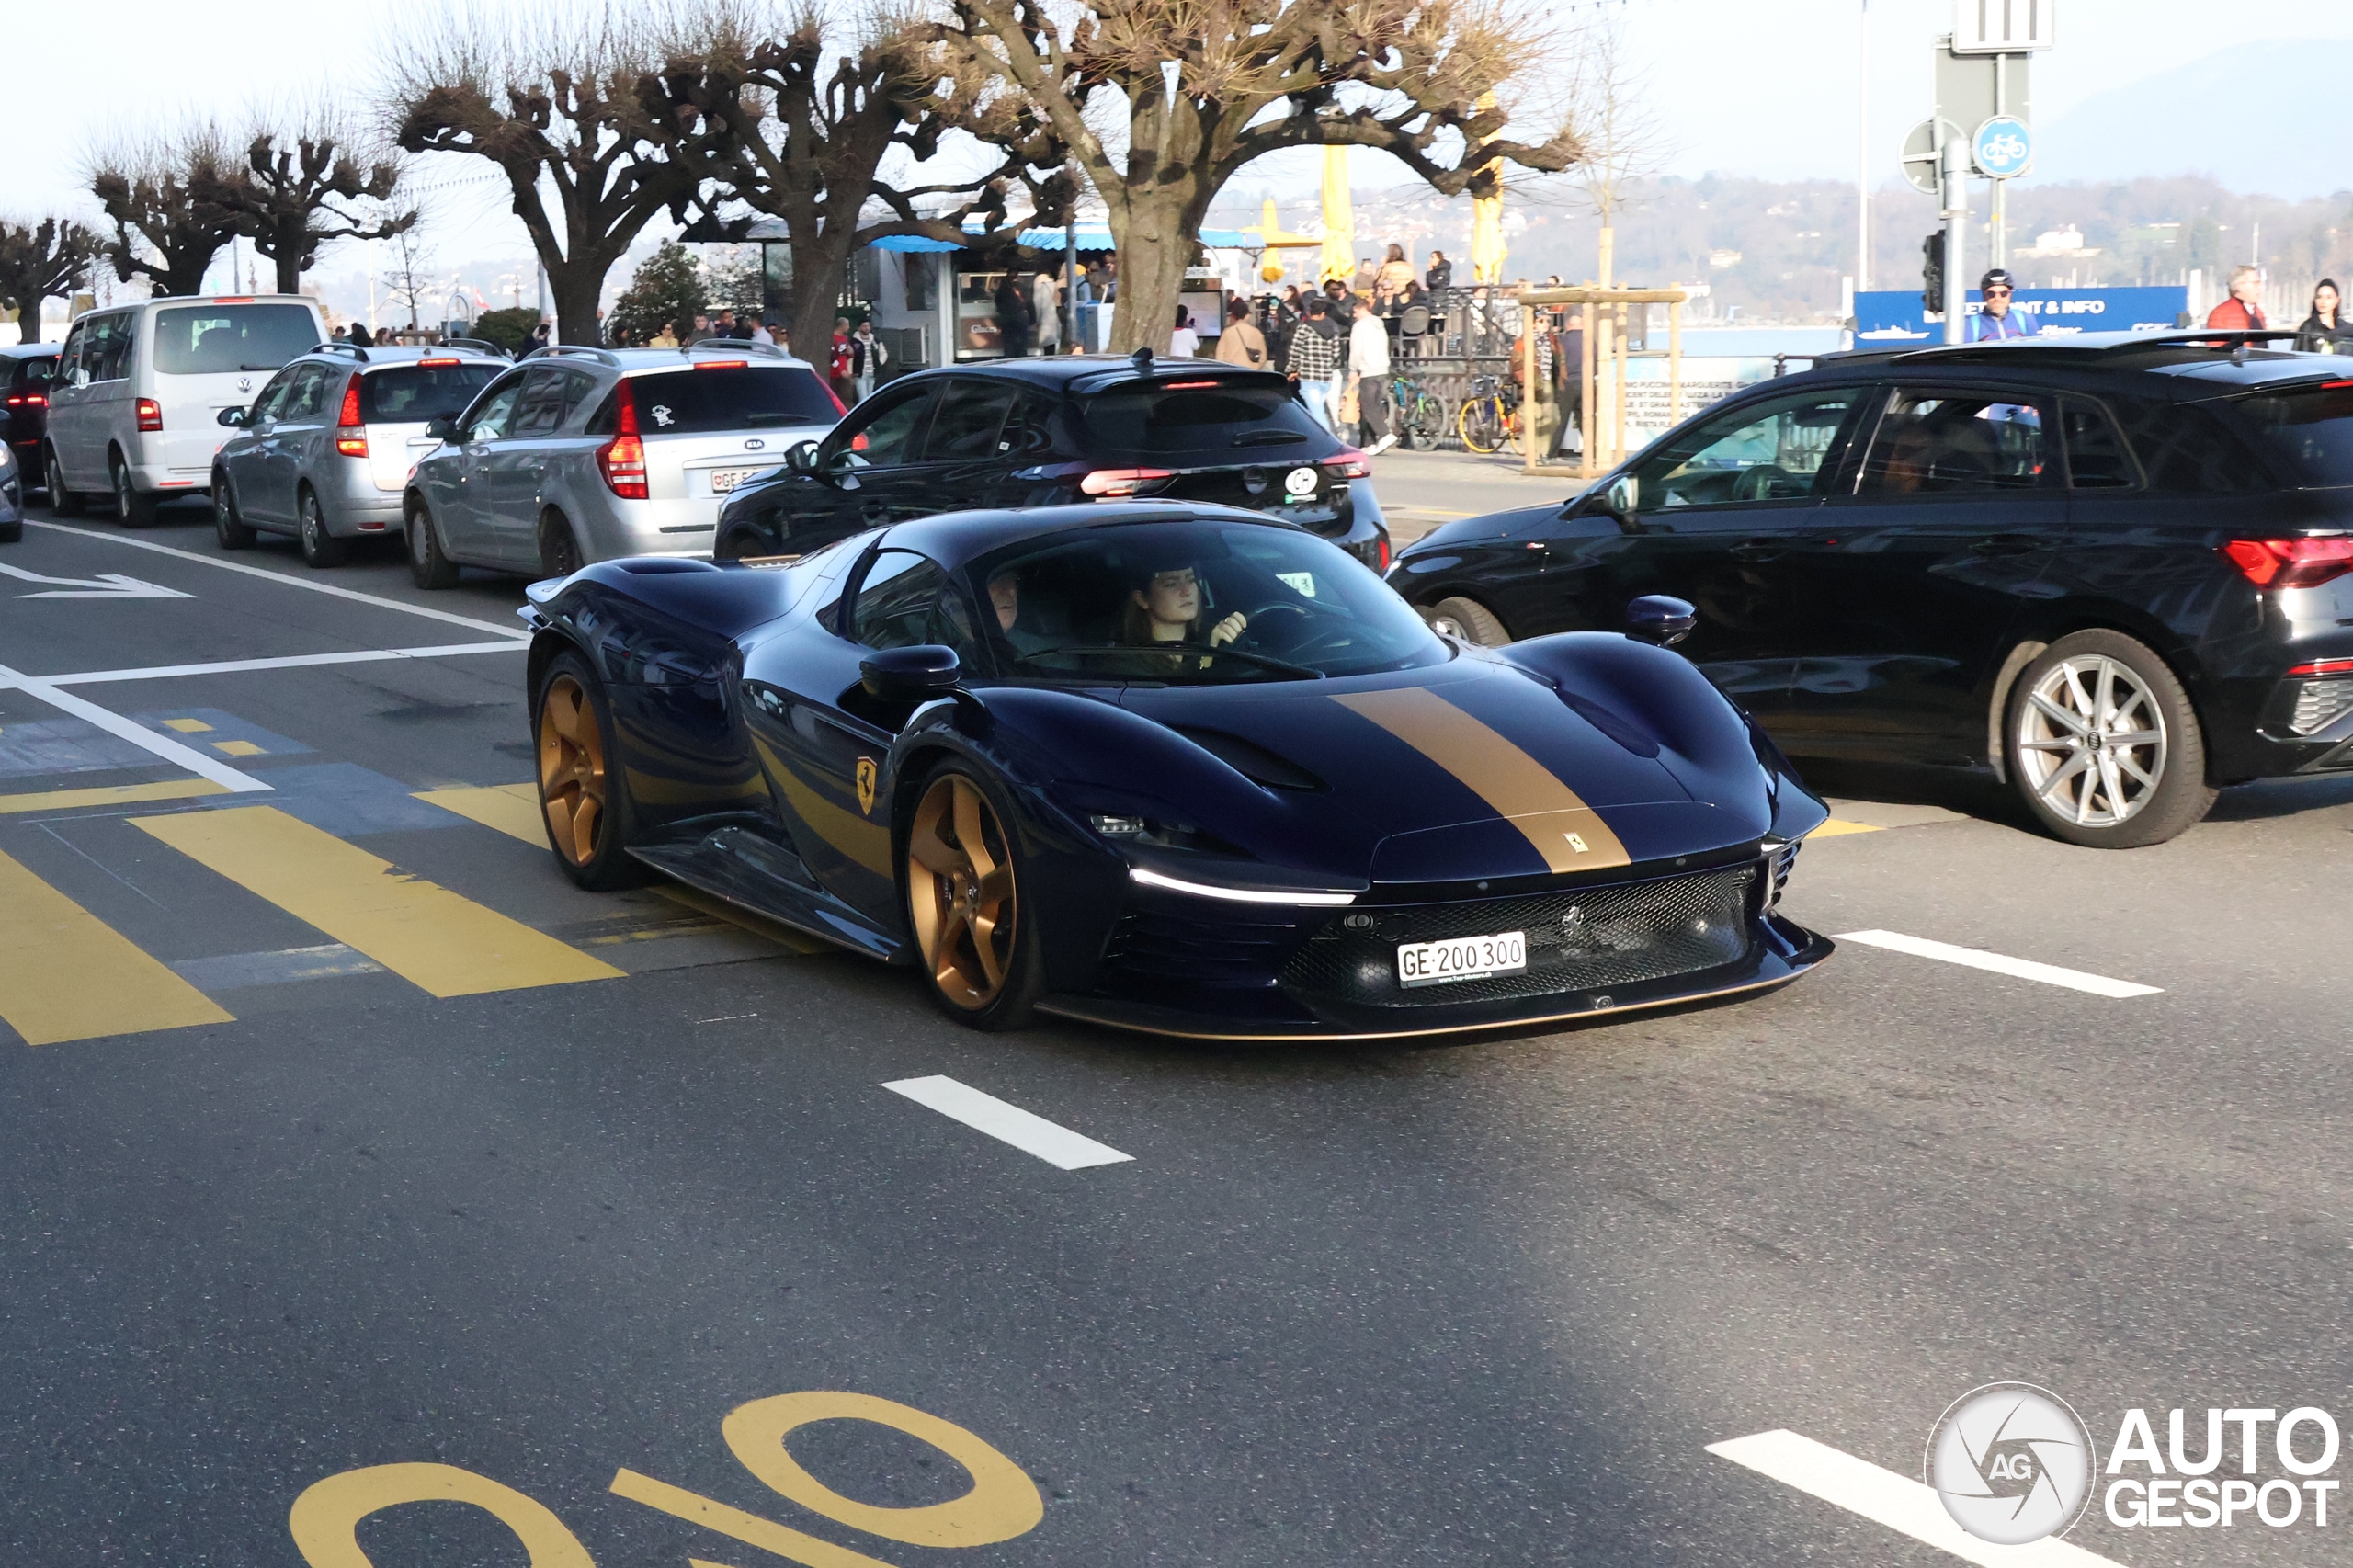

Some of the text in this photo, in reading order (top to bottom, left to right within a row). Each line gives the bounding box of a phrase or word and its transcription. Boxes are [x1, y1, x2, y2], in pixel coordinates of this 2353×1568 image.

[2045, 301, 2059, 315] &
[2062, 300, 2106, 314] INFO
[1293, 472, 1312, 490] CH
[1483, 939, 1521, 967] 300
